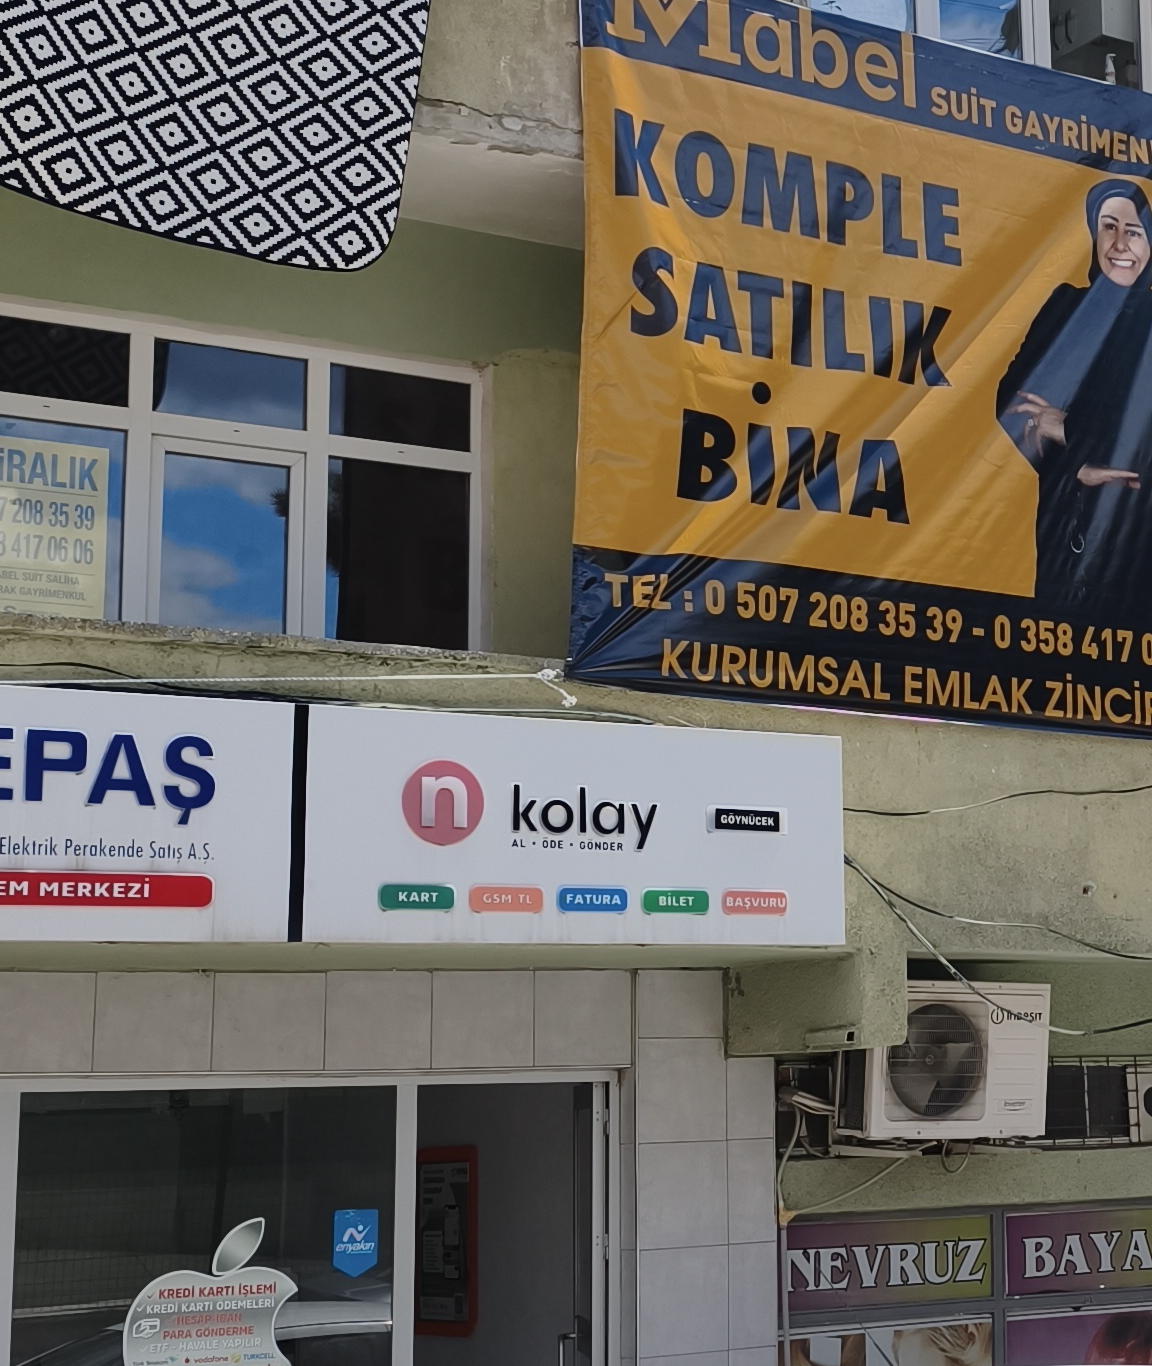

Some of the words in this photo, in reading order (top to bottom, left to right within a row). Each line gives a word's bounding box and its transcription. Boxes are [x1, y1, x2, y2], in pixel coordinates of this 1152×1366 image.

[930, 86, 997, 128] SUİT
[614, 108, 962, 266] KOMPLE
[630, 246, 952, 387] SATILIK
[676, 381, 910, 525] BİNA
[11, 498, 44, 526] 208
[48, 501, 70, 529] 35
[74, 503, 95, 531] 39
[11, 532, 44, 560] 417
[47, 536, 69, 563] 06
[73, 538, 94, 565] 06
[19, 586, 87, 602] GAYRİMENKUL
[604, 572, 671, 610] TEL
[704, 579, 725, 615] 0
[737, 581, 798, 624] 507
[809, 591, 869, 632] 208
[878, 600, 916, 638] 35
[926, 606, 963, 643] 39
[994, 615, 1011, 649] 0
[1020, 618, 1073, 656] 358
[1081, 625, 1133, 663] 417
[661, 638, 891, 701] KURUMSAL
[904, 665, 1033, 715] EMLAK
[512, 784, 658, 850] kolay
[720, 812, 775, 827] GÖYNÜCEK
[0, 835, 58, 857] Elektrik
[64, 838, 144, 859] Perakende
[149, 840, 183, 864] Satış
[188, 842, 215, 865] A.Ş.
[511, 838, 526, 848] AL
[542, 836, 564, 849] ÖDE
[579, 838, 624, 851] GÖNDER
[39, 877, 150, 898] MERKEZİ
[398, 891, 439, 903] KART
[482, 892, 512, 904] GSM
[518, 893, 533, 904] TL
[566, 893, 622, 905] FATURA
[658, 892, 695, 906] BİLET
[726, 896, 786, 910] BAŞVURU
[787, 1236, 988, 1293] NEVRUZ
[158, 1285, 195, 1300] KREDİ
[199, 1285, 235, 1298] KARTI
[238, 1281, 277, 1298] İŞLEMİ
[146, 1300, 178, 1315] KREDİ
[181, 1301, 213, 1313] KARTI
[216, 1296, 275, 1311] ÖDEMELERİ
[162, 1330, 193, 1340] PARA
[195, 1325, 254, 1338] GÖNDERME
[180, 1339, 218, 1352] HAVALE
[193, 1355, 229, 1364] vodafone
